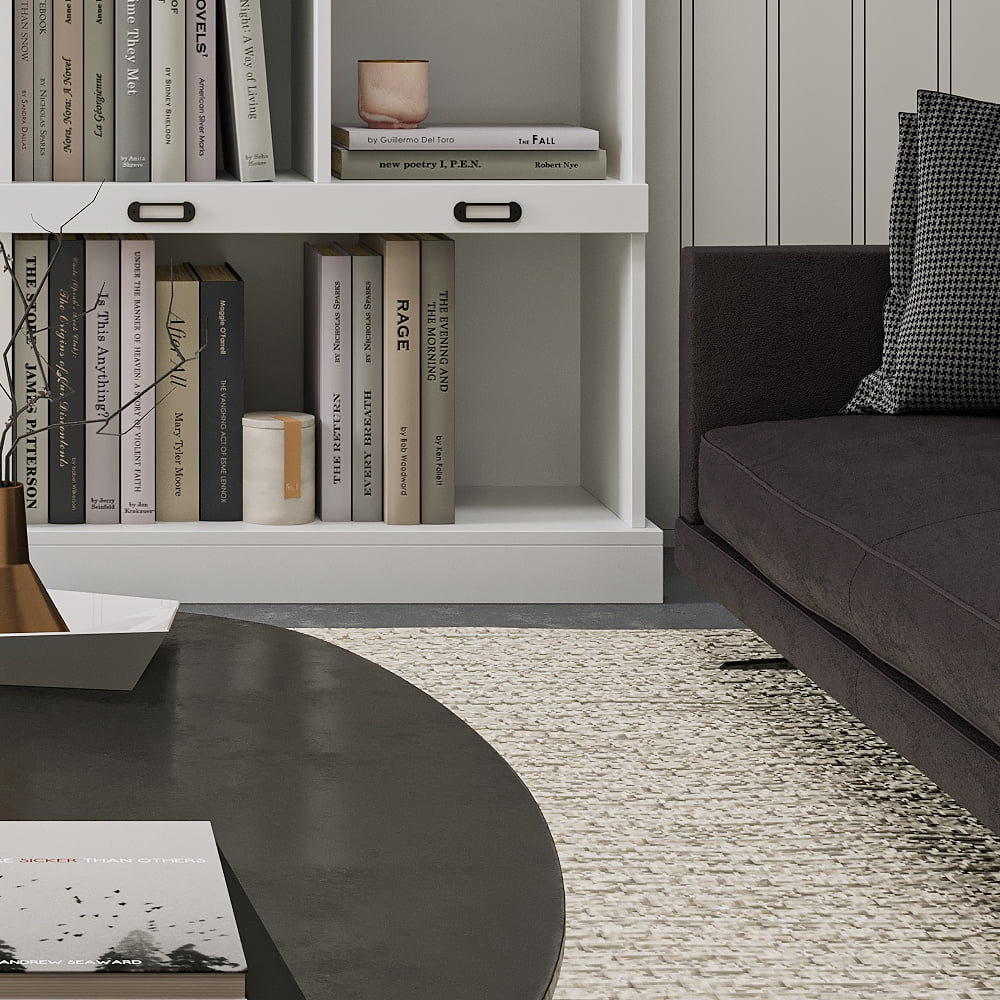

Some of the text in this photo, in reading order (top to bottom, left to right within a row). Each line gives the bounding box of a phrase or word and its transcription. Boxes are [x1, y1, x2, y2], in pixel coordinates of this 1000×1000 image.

[532, 135, 555, 144] FALL
[403, 160, 436, 170] poetry
[440, 160, 447, 170] I,
[450, 160, 481, 168] P.E.N.
[563, 162, 578, 170] Nye
[97, 311, 109, 417] This Anything?
[175, 413, 183, 496] Mary Tyler Moore
